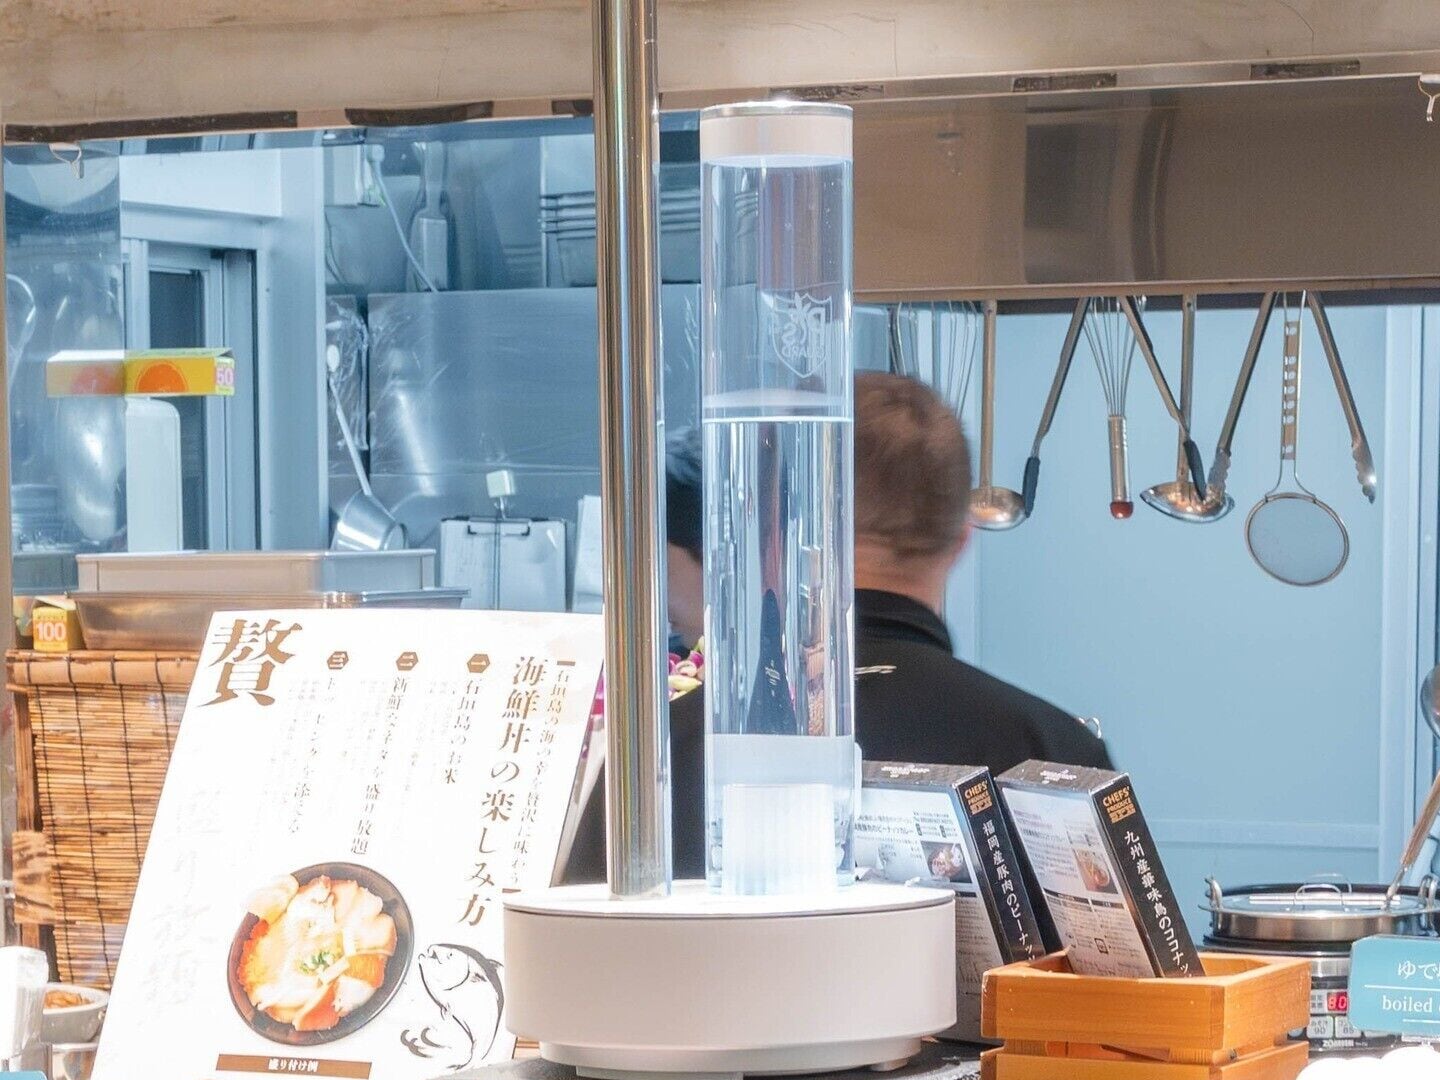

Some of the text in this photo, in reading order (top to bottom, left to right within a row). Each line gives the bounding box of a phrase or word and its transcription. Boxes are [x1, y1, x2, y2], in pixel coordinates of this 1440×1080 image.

[36, 622, 66, 641] 100
[458, 656, 547, 927] 海鮮丼の楽しみ方
[1124, 830, 1194, 977] 九州産華味鳥のココナッ
[1382, 995, 1433, 1013] boiled
